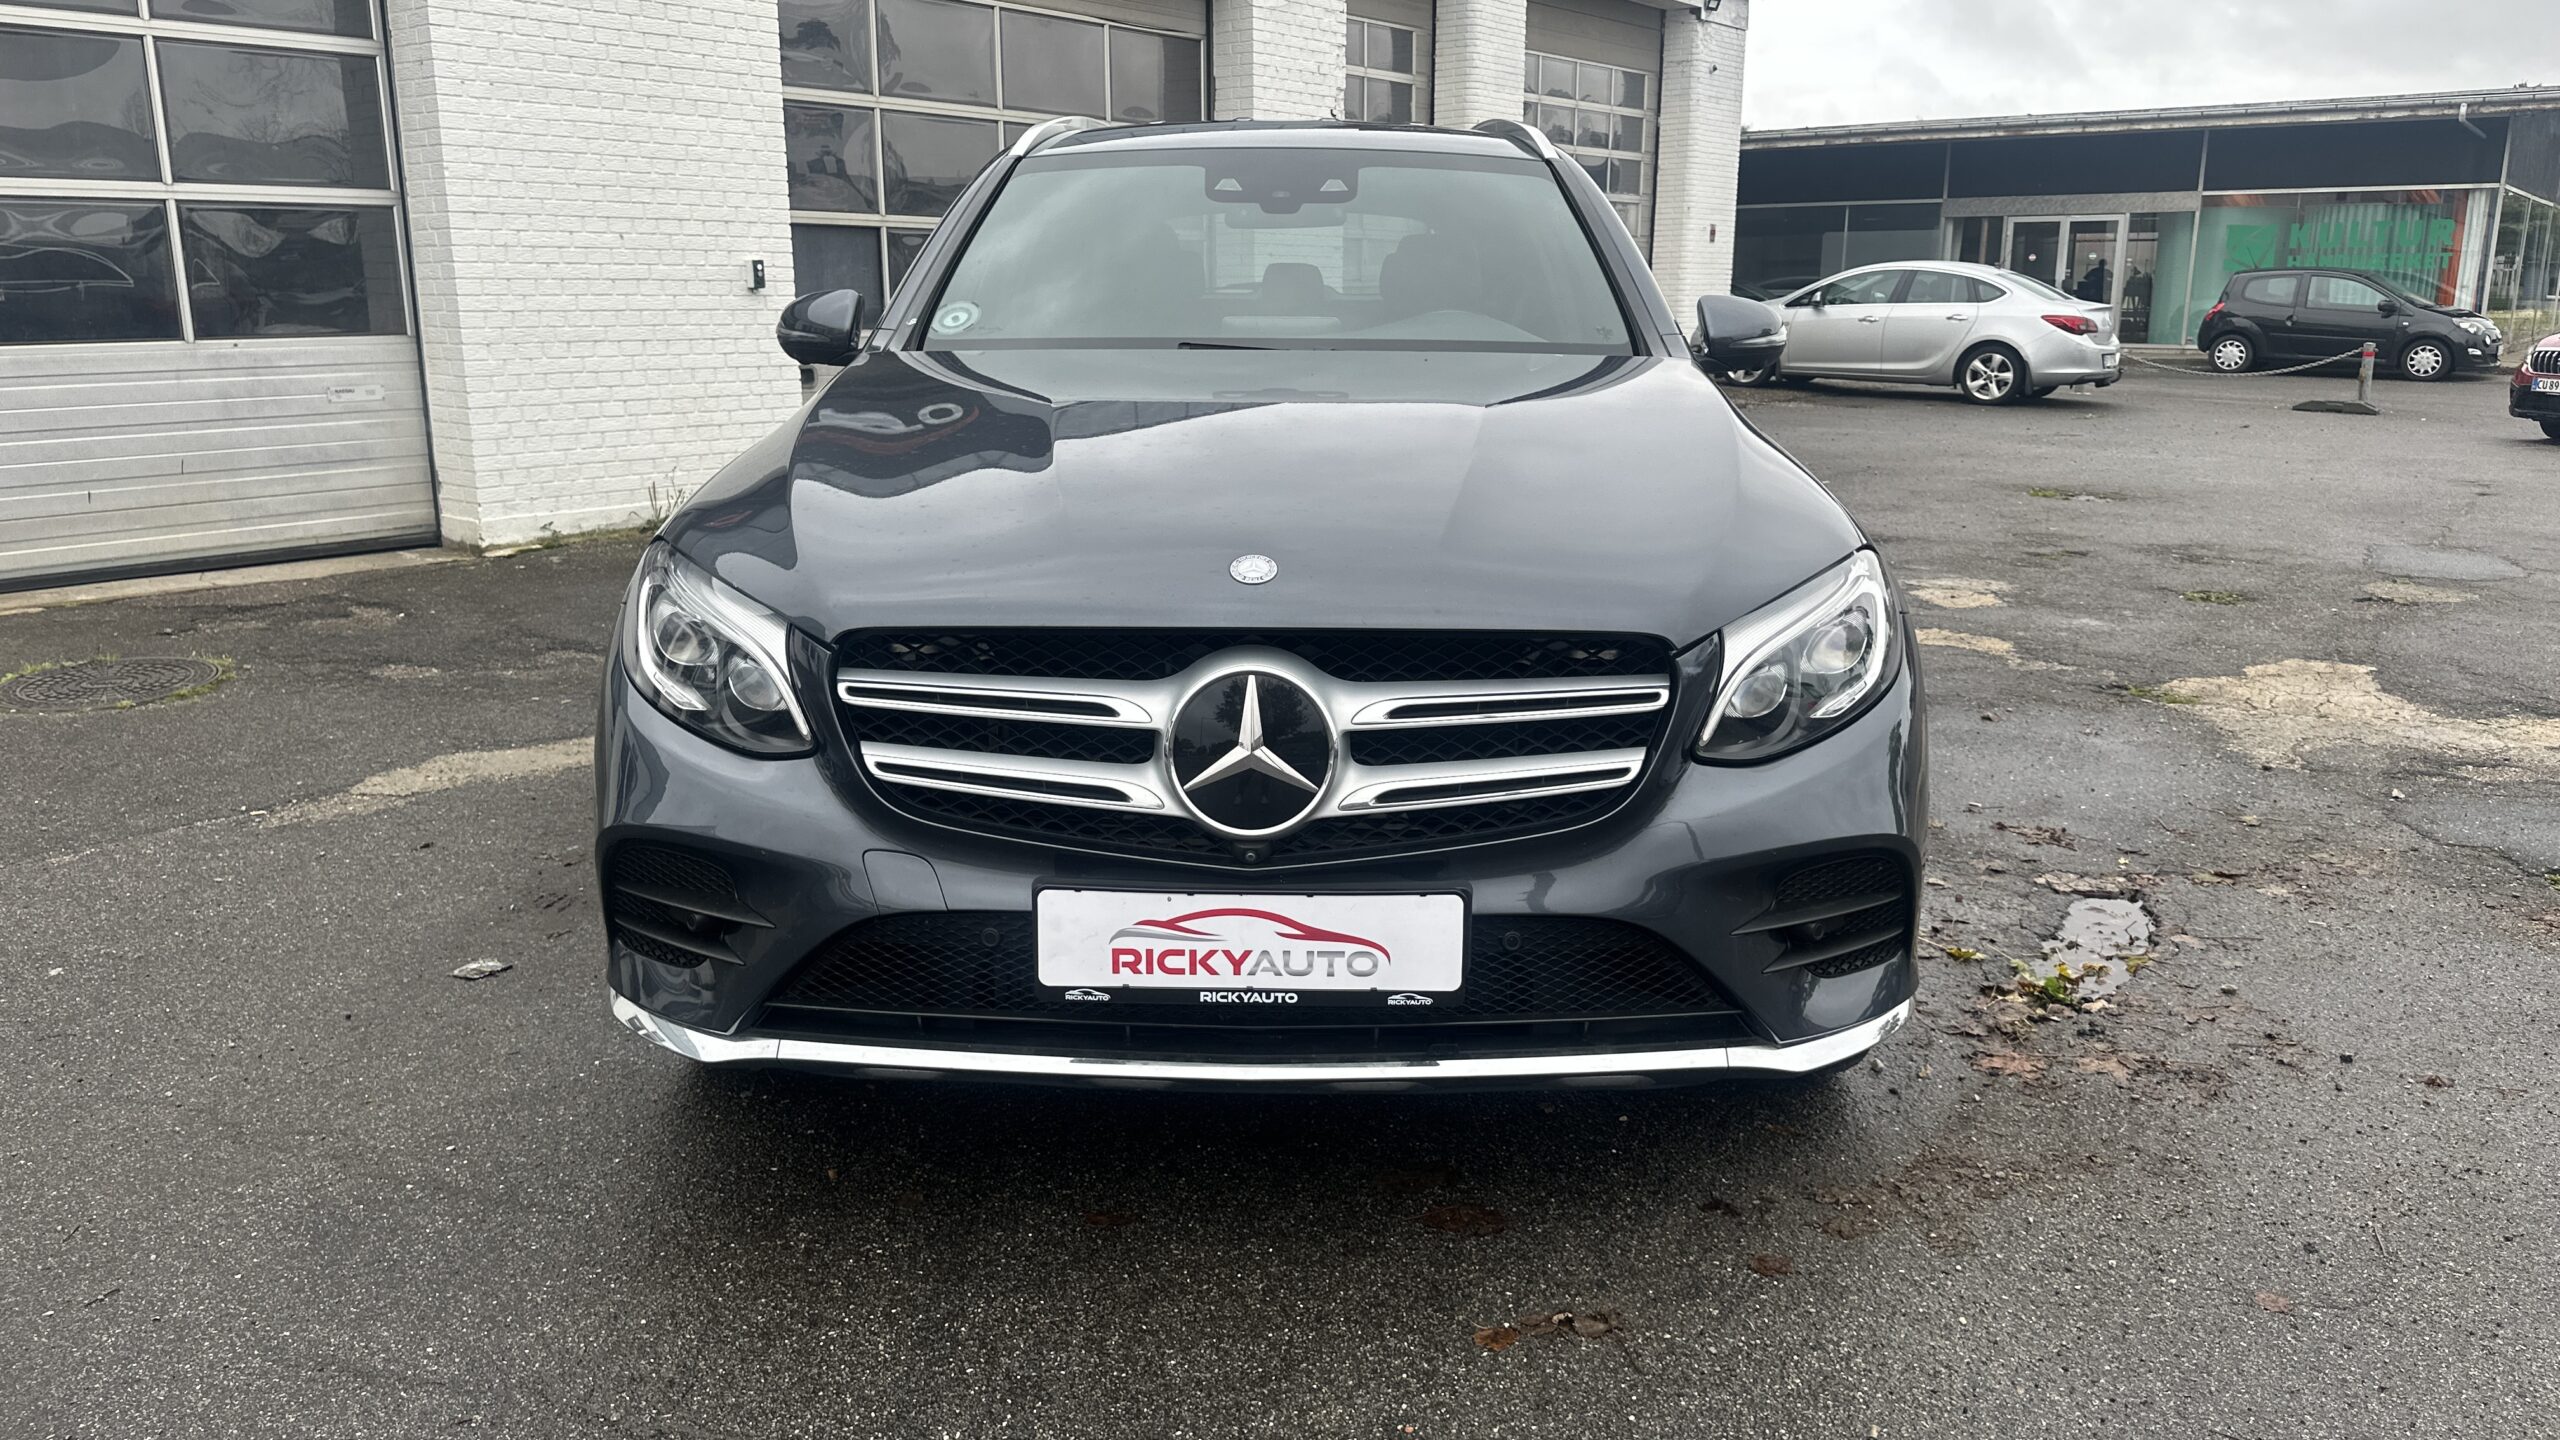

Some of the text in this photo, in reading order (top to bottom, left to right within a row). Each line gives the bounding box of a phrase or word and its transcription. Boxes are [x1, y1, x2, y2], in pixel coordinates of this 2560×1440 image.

[2289, 218, 2456, 249] KULTUR
[1111, 947, 1379, 978] RICKYAUTO
[1065, 994, 1109, 1002] RICKYAUTO
[1199, 991, 1299, 1004] RICKYAUTO
